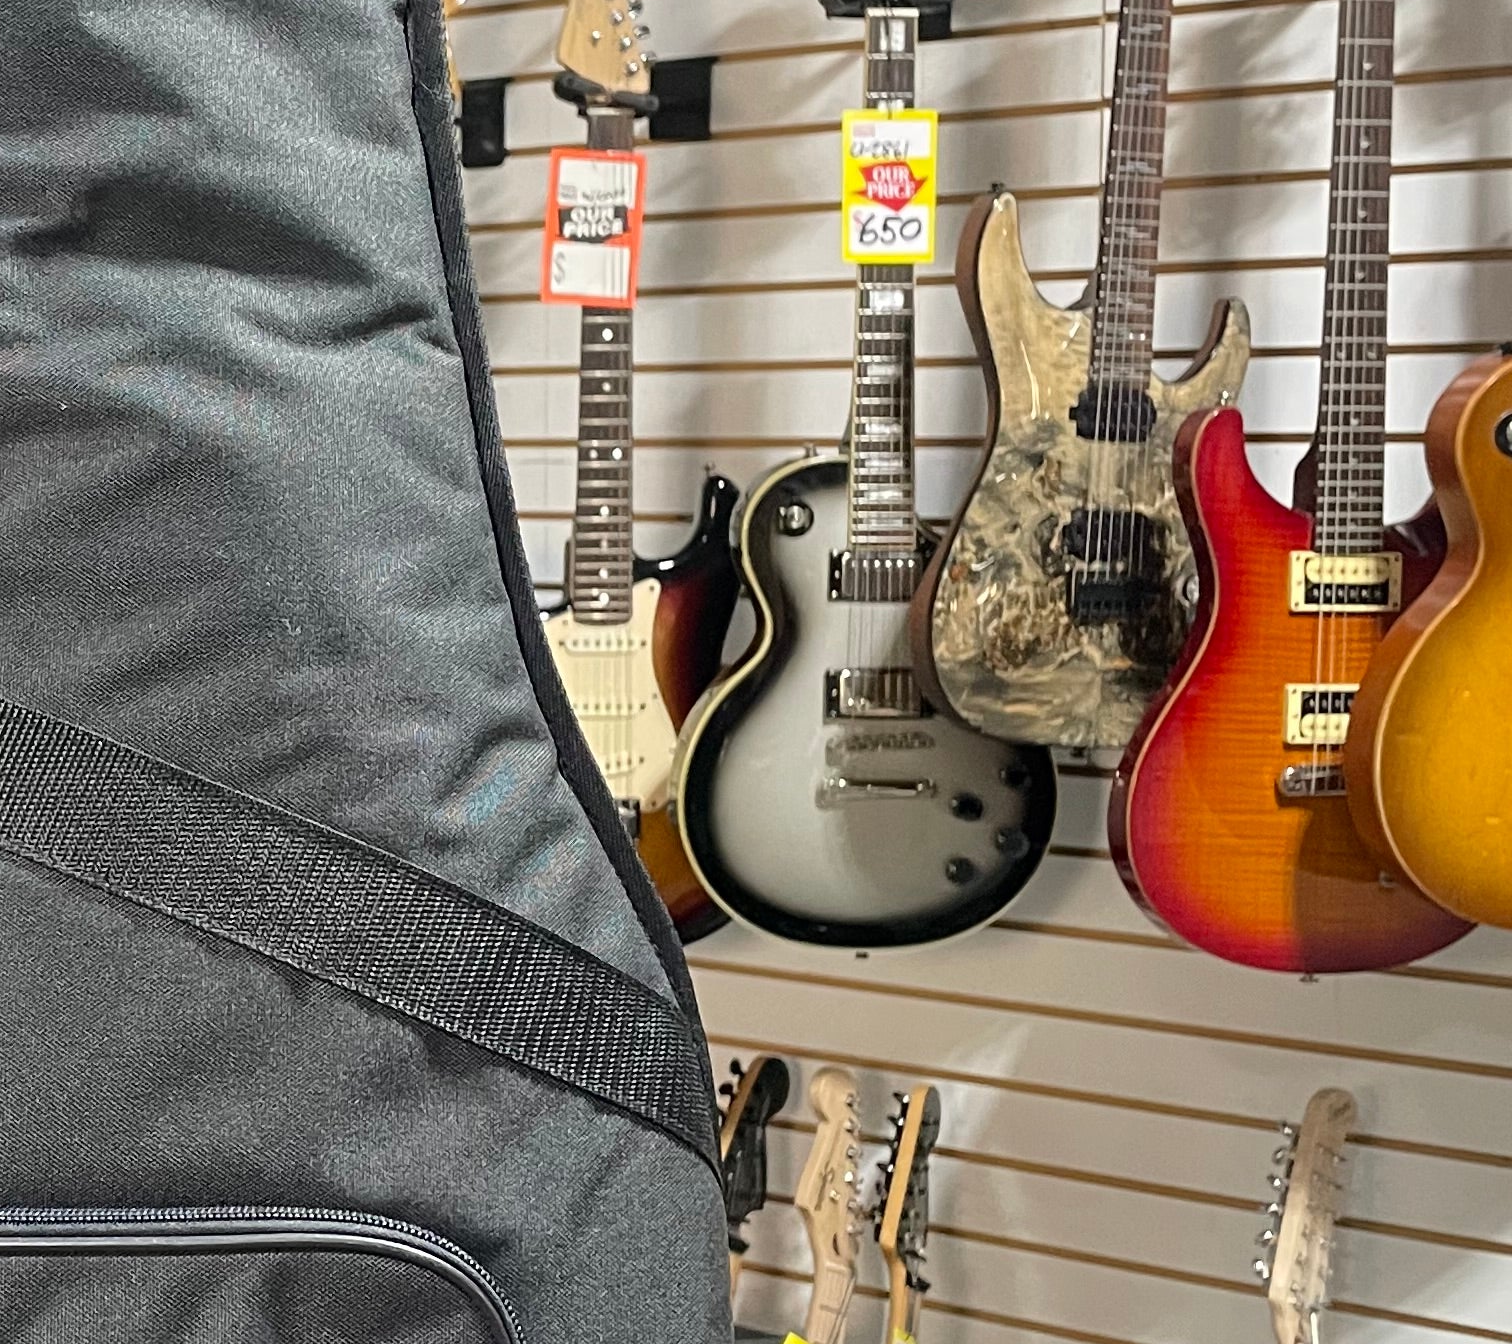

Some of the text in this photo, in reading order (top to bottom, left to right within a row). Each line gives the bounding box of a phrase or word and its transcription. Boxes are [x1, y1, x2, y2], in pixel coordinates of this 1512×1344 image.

[872, 165, 911, 183] OUR
[867, 181, 916, 200] PRICE
[570, 207, 615, 224] OUR
[562, 218, 624, 238] PRICE
